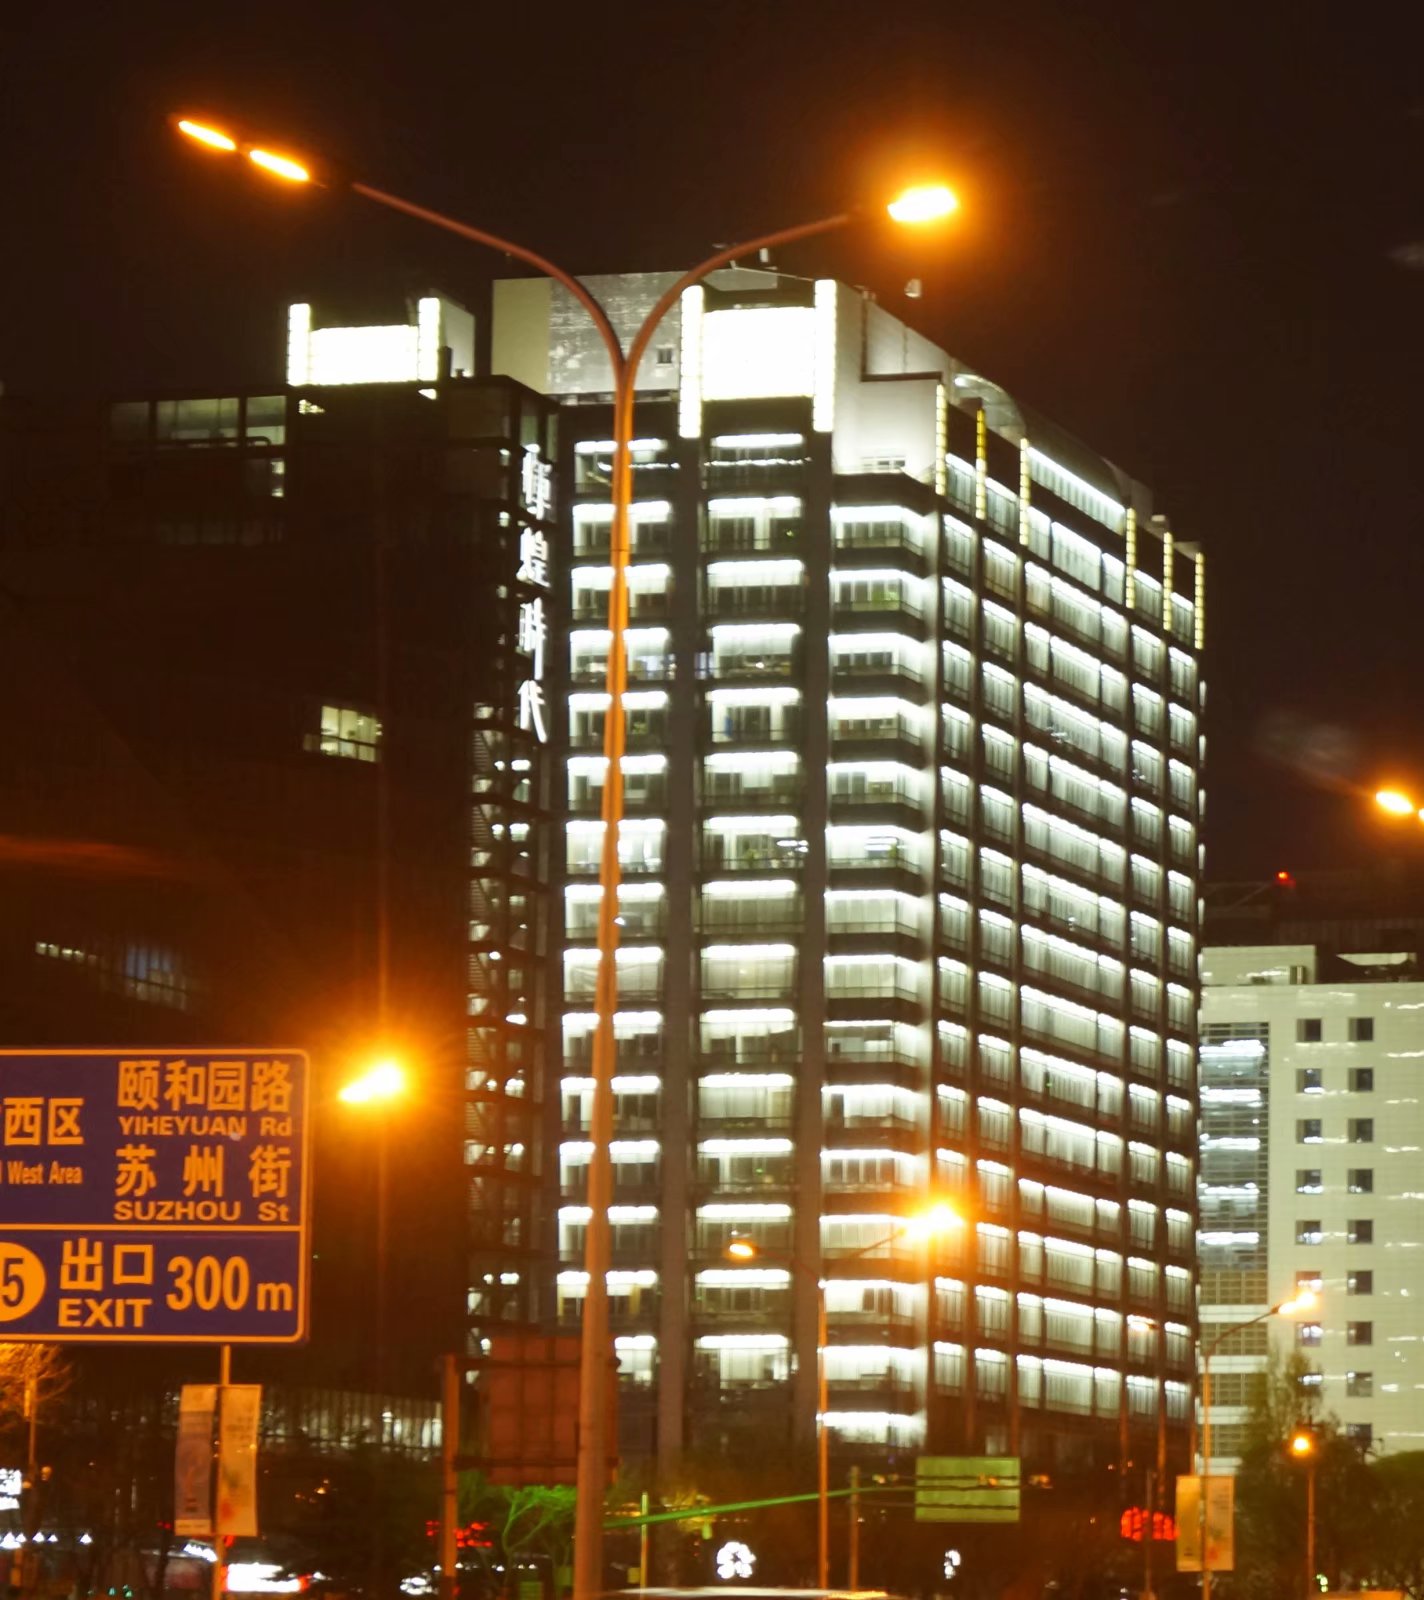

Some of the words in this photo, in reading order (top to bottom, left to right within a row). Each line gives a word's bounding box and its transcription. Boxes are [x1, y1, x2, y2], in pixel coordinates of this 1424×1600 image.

[117, 1060, 293, 1113] 颐和园路
[119, 1116, 247, 1137] YIHEYUAN
[259, 1116, 293, 1137] Rd
[7, 1160, 44, 1185] West
[48, 1160, 83, 1185] Area
[115, 1144, 293, 1199] 苏州街
[113, 1200, 241, 1222] SUZHOU
[258, 1201, 289, 1222] St
[59, 1237, 154, 1292] 出口
[166, 1255, 250, 1311] 300
[256, 1282, 293, 1312] m
[58, 1297, 153, 1328] EXIT
